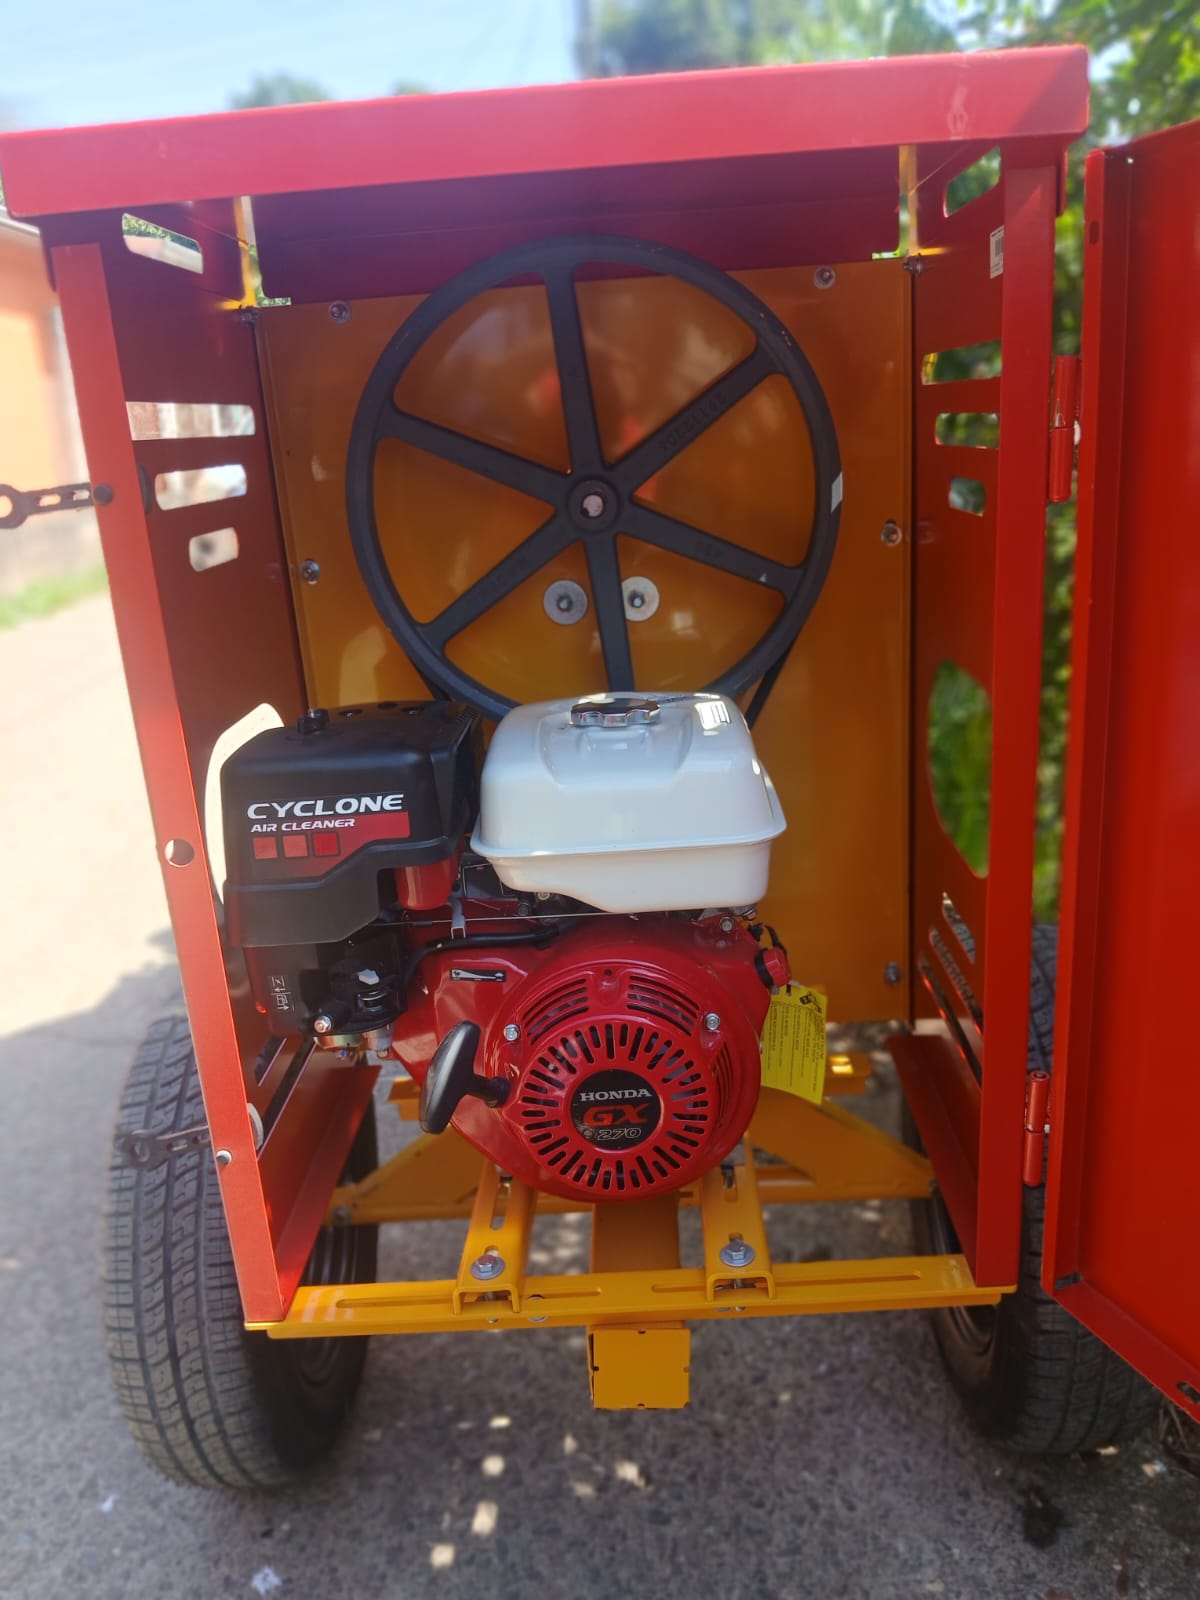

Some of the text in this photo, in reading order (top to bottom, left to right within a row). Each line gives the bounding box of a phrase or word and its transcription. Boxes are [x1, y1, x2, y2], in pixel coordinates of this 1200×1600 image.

[247, 794, 404, 819] CYCLONE
[251, 819, 356, 833] AIR CLEANER
[580, 1089, 652, 1102] HONDA
[583, 1103, 649, 1126] GX
[597, 1128, 641, 1141] 270
